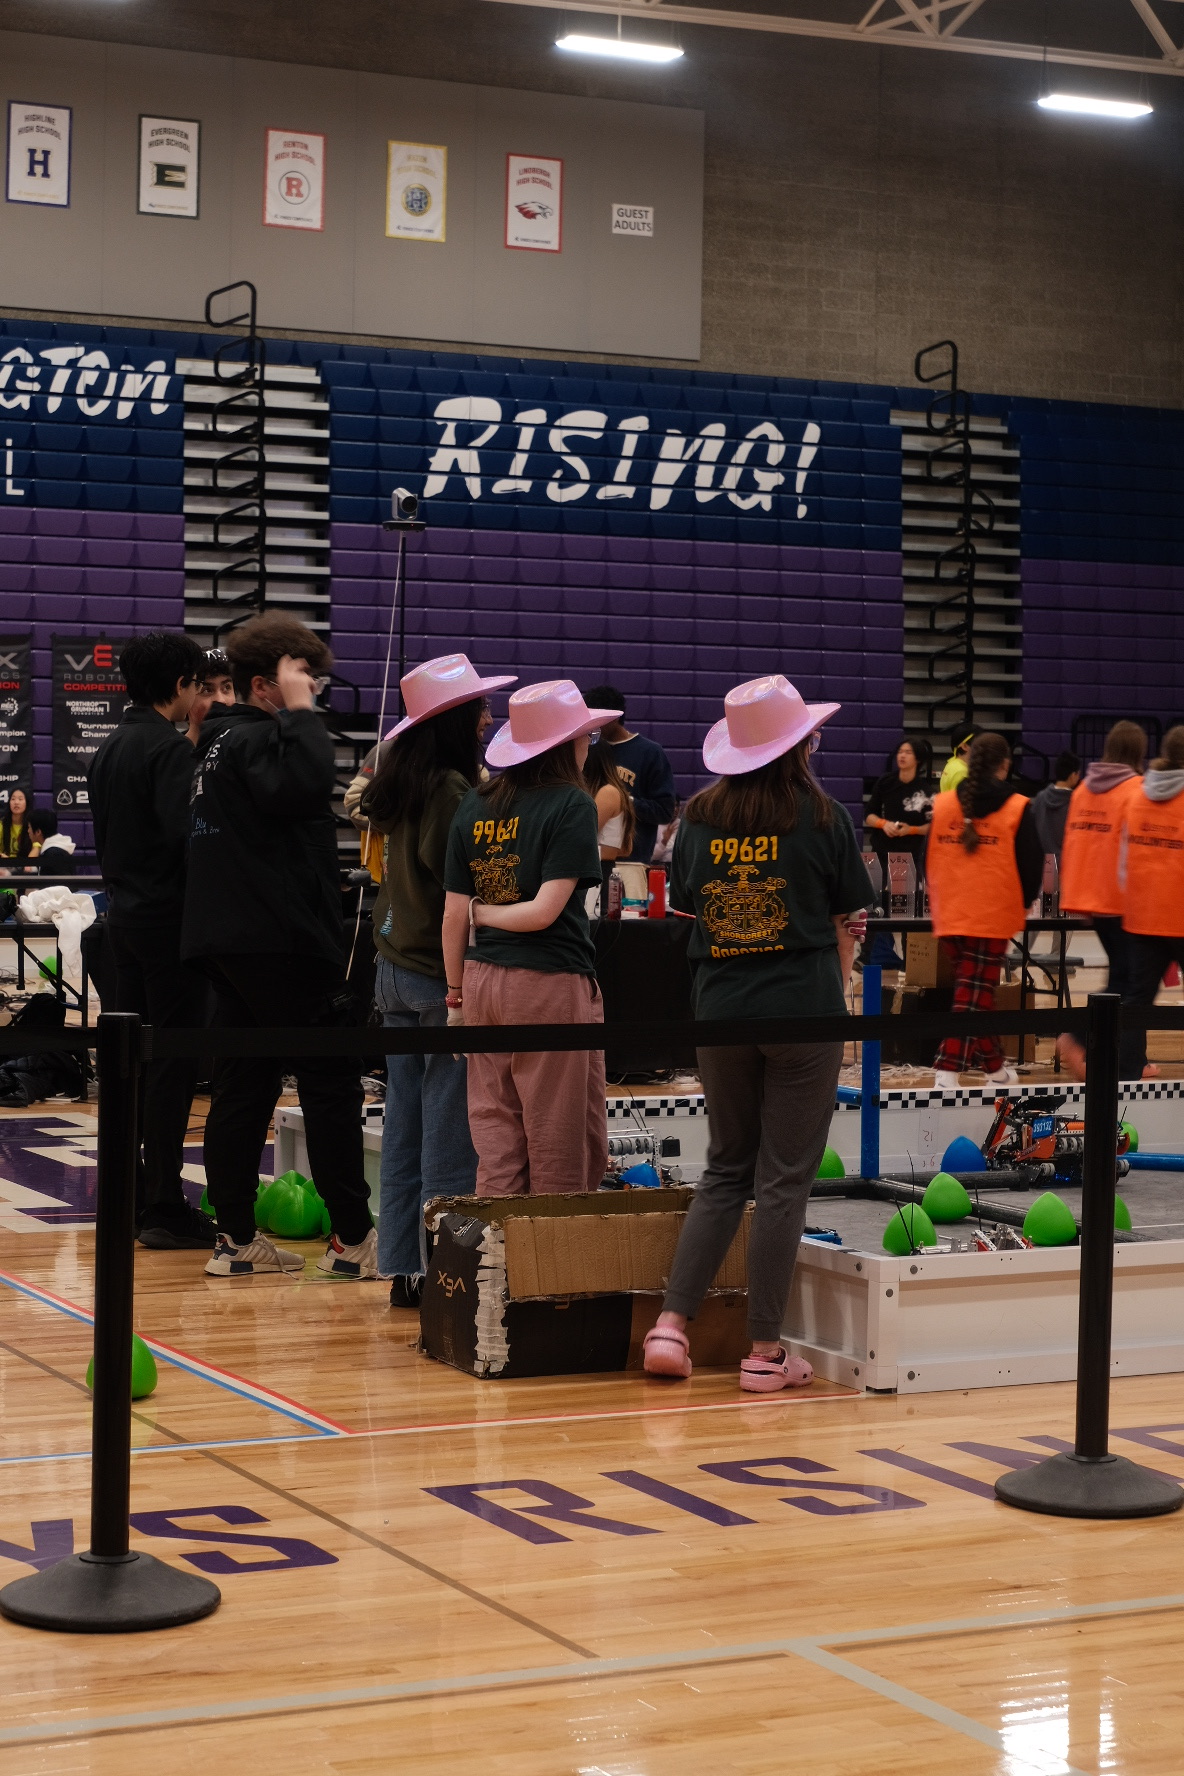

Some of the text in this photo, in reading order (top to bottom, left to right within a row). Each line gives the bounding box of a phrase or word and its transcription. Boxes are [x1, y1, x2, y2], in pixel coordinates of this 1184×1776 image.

[151, 127, 189, 140] EVERGREEN
[148, 138, 191, 153] HIGH SCHOOL
[27, 148, 51, 178] H
[518, 167, 551, 178] LINDBERGH
[285, 176, 304, 198] R
[516, 176, 554, 190] HIGH SCHOOL
[616, 207, 650, 219] GUEST
[613, 220, 652, 232] ADULTS
[423, 396, 821, 519] RISING!
[67, 775, 88, 783] CHA
[472, 816, 520, 845] 99621
[710, 835, 778, 865] 99621
[719, 929, 773, 940] SHORECREST
